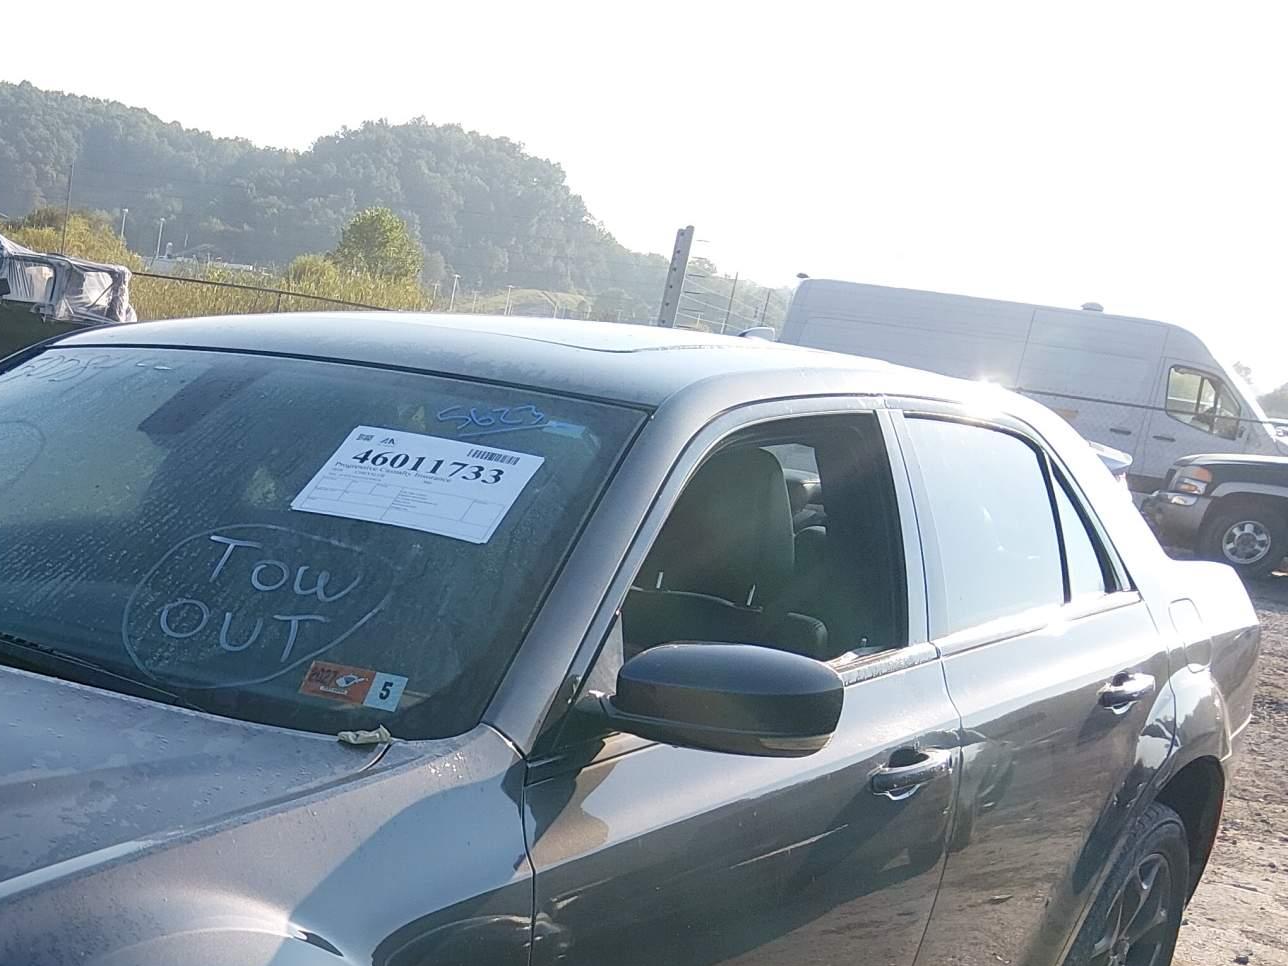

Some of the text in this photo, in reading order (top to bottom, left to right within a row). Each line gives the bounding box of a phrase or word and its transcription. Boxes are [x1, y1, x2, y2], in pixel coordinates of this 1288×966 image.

[352, 449, 504, 485] 46011733
[161, 599, 331, 663] OUT
[379, 681, 394, 700] 5
